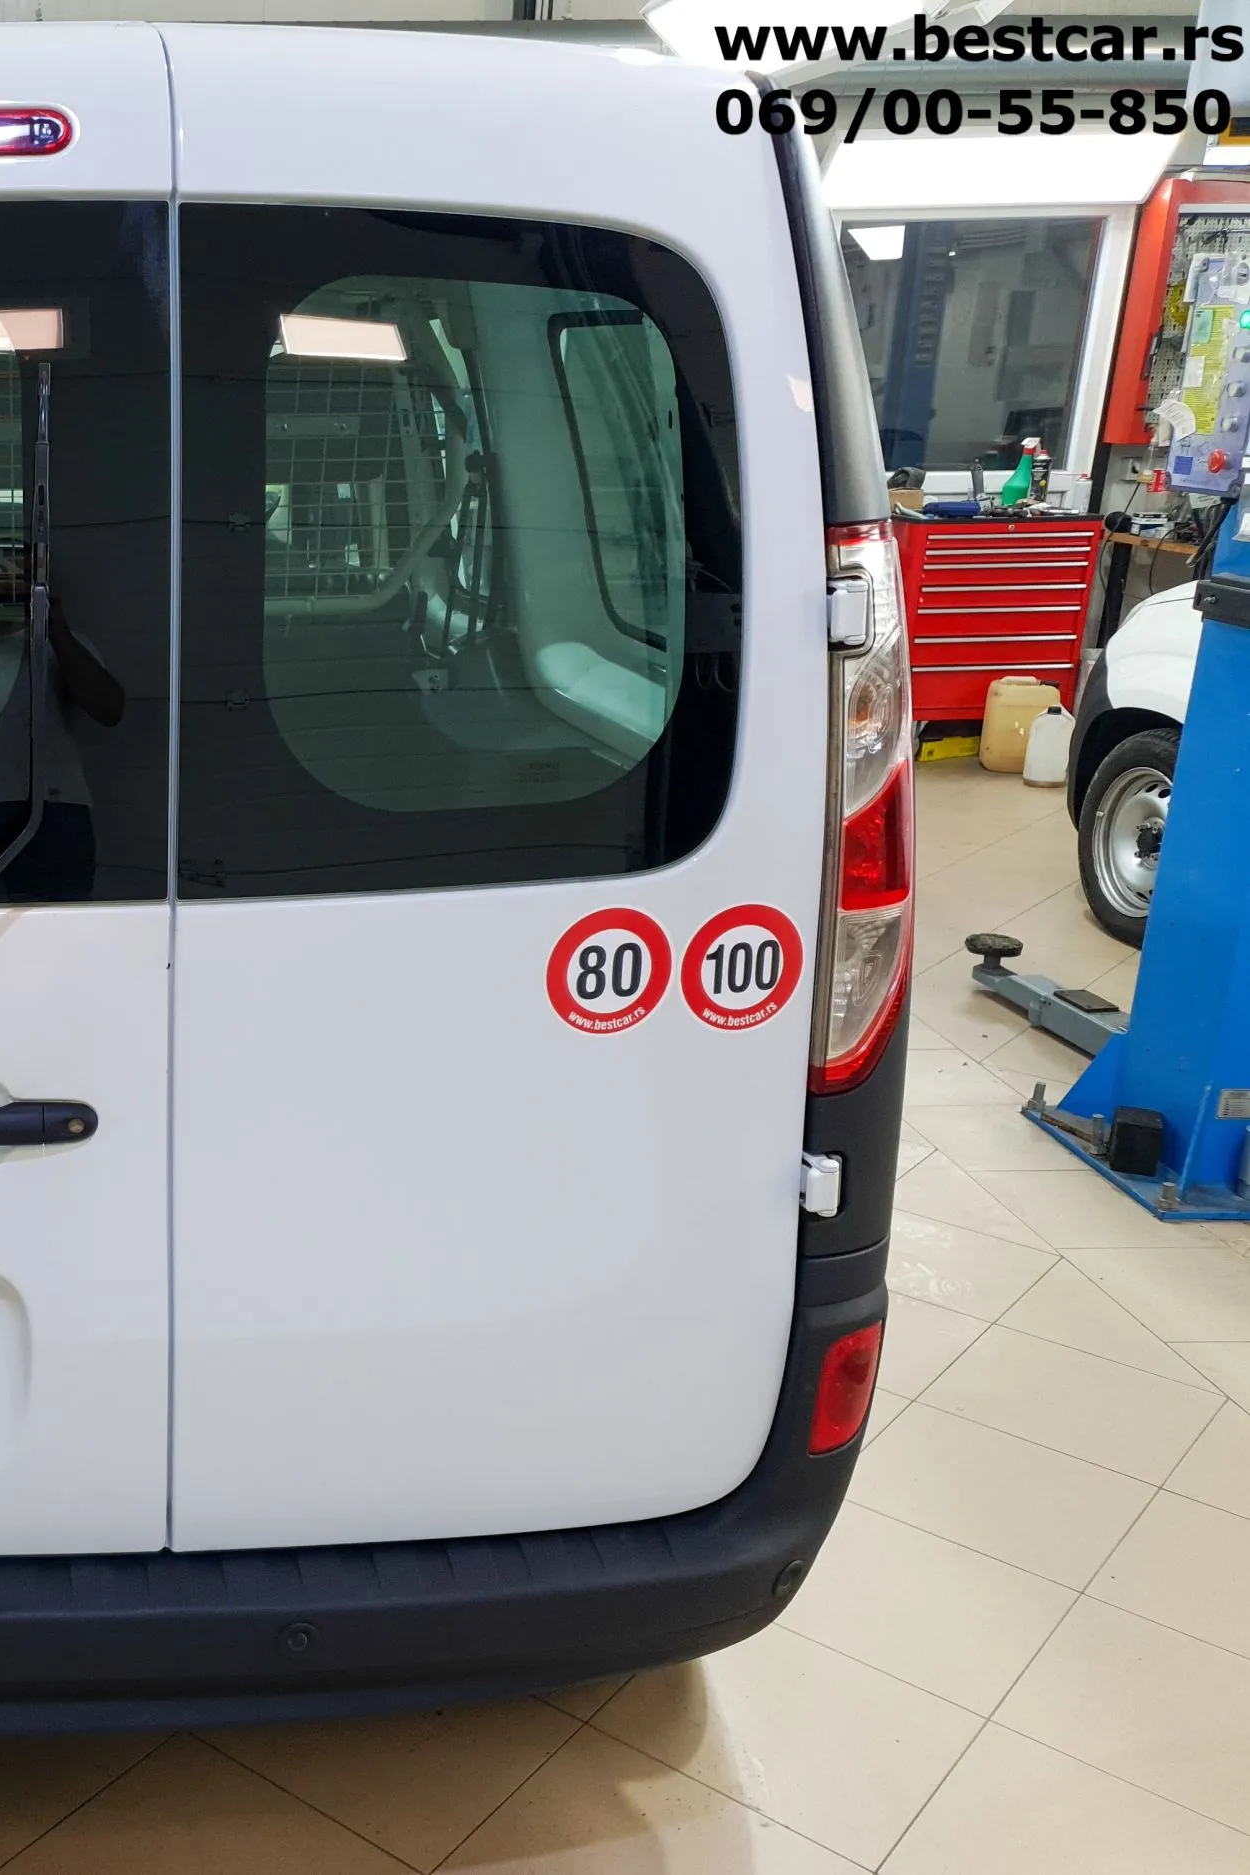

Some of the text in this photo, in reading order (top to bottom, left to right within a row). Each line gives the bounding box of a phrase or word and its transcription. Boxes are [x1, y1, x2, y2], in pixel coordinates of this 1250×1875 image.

[575, 942, 643, 1000] 80
[705, 939, 780, 995] 100
[567, 1006, 646, 1030] www.bestcar.rs
[702, 1001, 778, 1026] www.bestcar.rs
